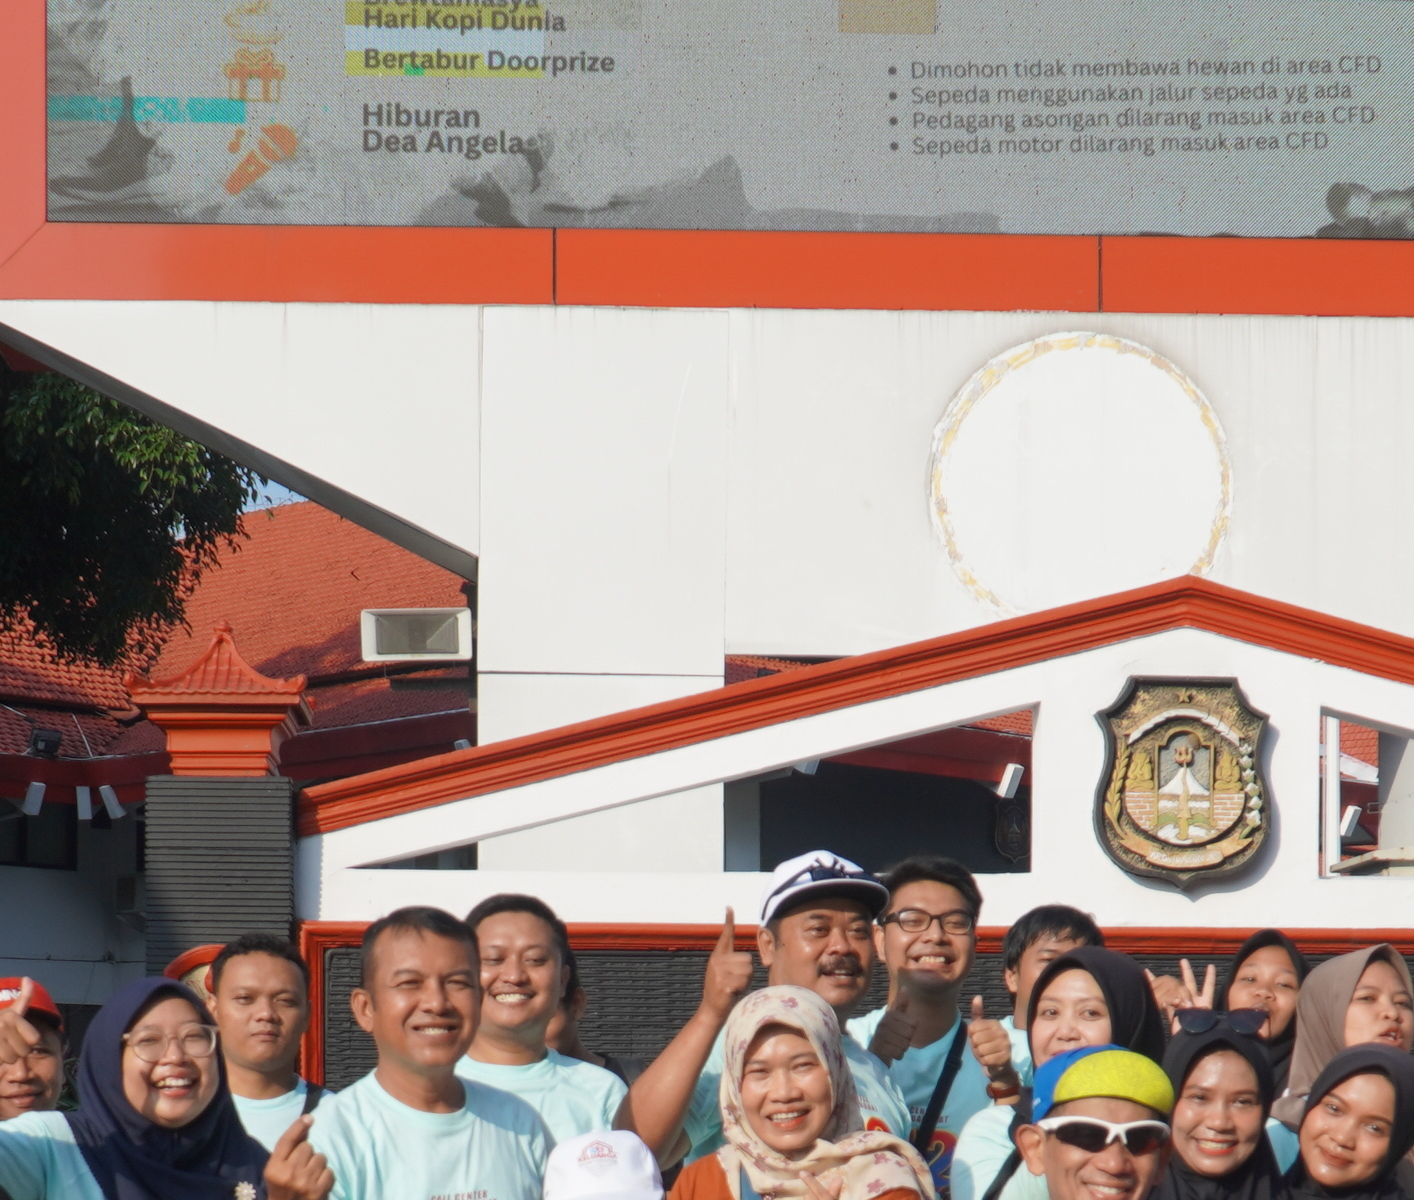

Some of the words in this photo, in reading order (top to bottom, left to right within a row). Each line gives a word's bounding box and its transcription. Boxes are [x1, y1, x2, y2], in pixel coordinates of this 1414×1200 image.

[364, 9, 418, 29] Hari
[426, 10, 483, 36] Kopi
[491, 11, 566, 32] Dunia
[364, 49, 480, 71] Bertabur
[488, 51, 616, 76] Doorprize
[912, 61, 1008, 79] Dimohon
[1015, 59, 1066, 78] tidak
[1072, 58, 1181, 78] membawa
[1187, 57, 1255, 76] hewan
[1262, 56, 1281, 74] di
[1287, 59, 1332, 74] area
[1339, 55, 1383, 74] CFD
[912, 86, 989, 107] Sepeda
[998, 84, 1143, 107] menggunakan
[1147, 83, 1195, 106] jalur
[1203, 81, 1278, 104] sepeda
[1285, 83, 1308, 104] yg
[1314, 81, 1353, 99] ada
[363, 103, 480, 128] Hiburan
[913, 111, 1016, 134] Pedagang
[1022, 112, 1109, 132] asongan
[1116, 108, 1201, 131] dilarang
[1208, 107, 1275, 126] masuk
[1280, 109, 1325, 125] area
[1333, 106, 1376, 125] CFD
[363, 130, 418, 152] Dea
[425, 130, 524, 160] Angela
[913, 136, 991, 158] Sepeda
[999, 137, 1063, 154] motor
[1070, 135, 1155, 157] dilarang
[1162, 133, 1229, 151] masuk
[1237, 133, 1279, 150] area
[1286, 131, 1329, 149] CFD
